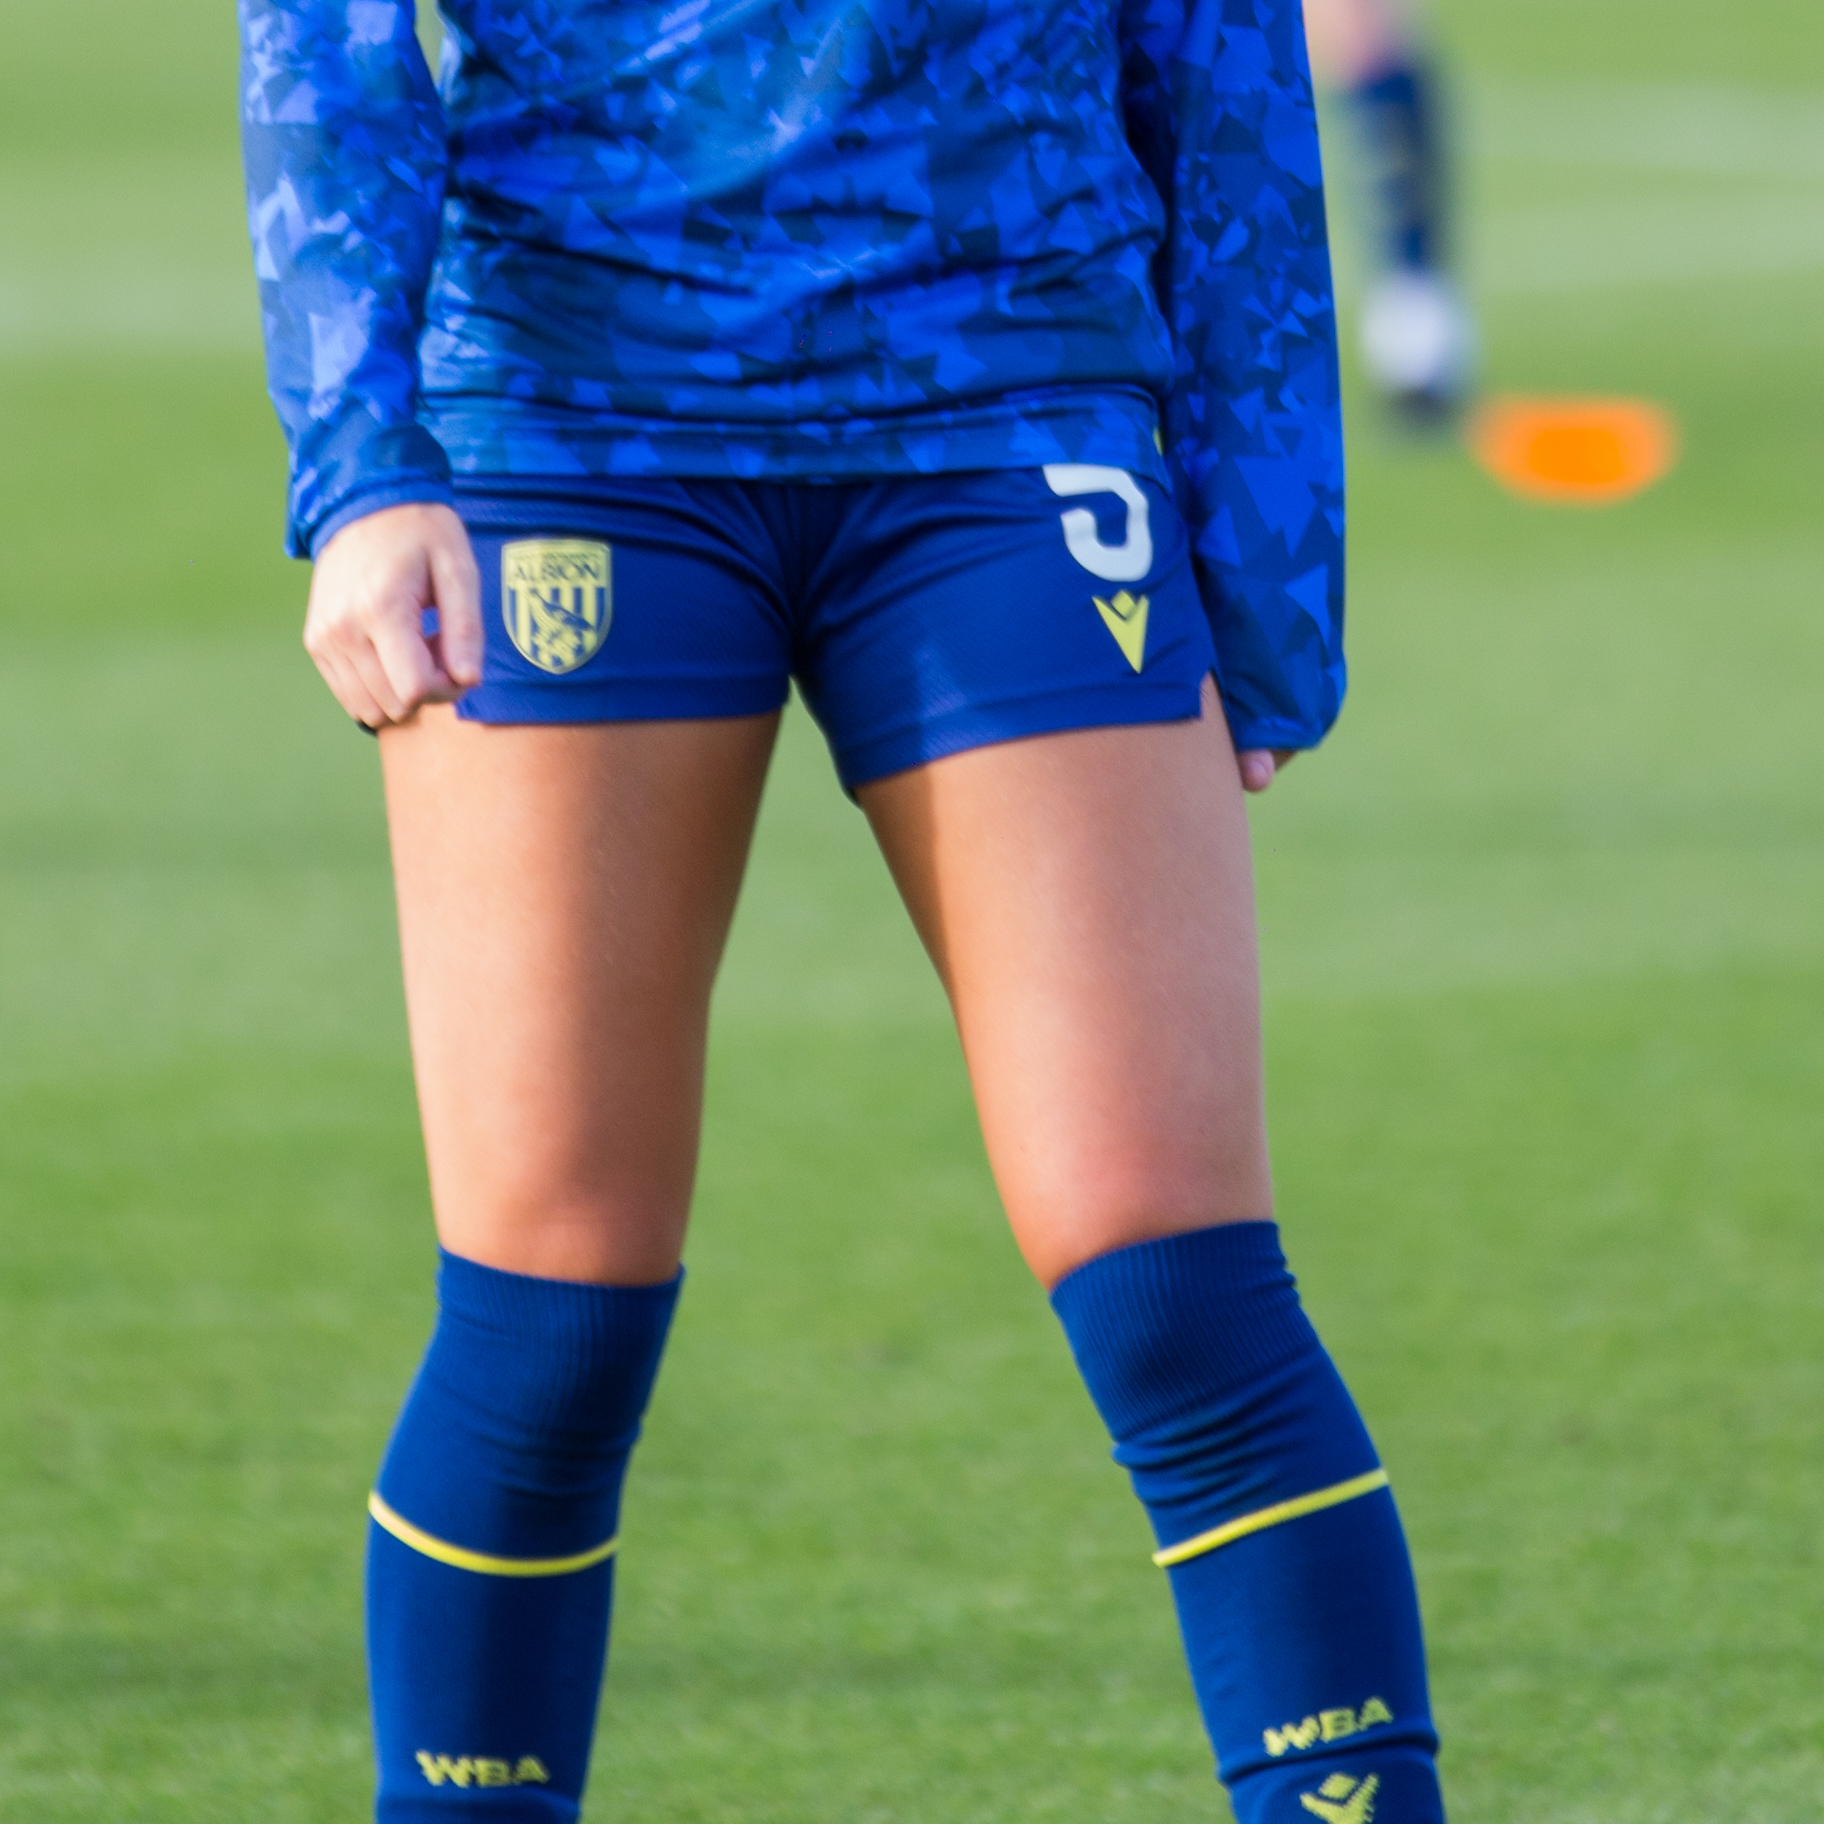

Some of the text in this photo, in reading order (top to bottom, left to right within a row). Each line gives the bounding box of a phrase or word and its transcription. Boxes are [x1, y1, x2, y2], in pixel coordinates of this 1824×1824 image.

[513, 559, 600, 581] ALBION
[1263, 1696, 1394, 1757] WBA
[415, 1749, 550, 1788] WBA
